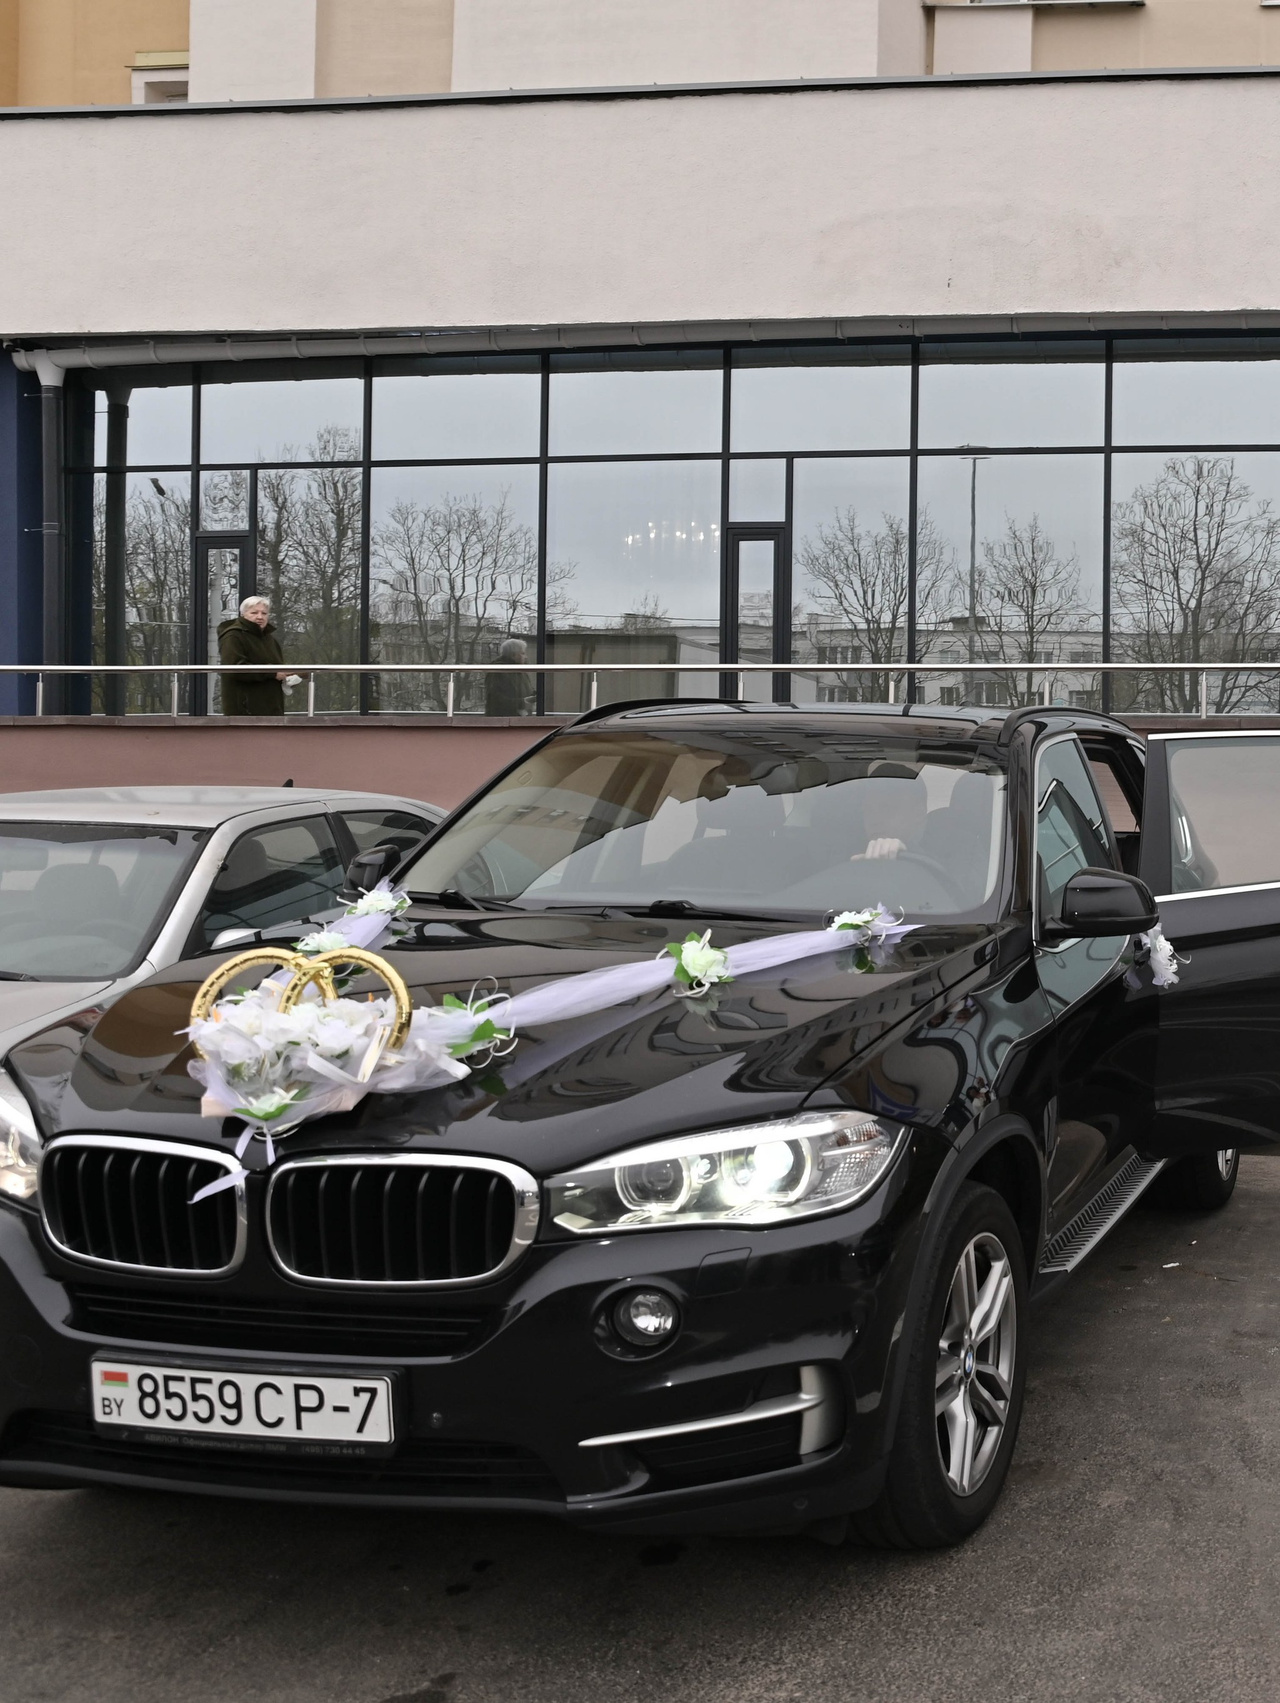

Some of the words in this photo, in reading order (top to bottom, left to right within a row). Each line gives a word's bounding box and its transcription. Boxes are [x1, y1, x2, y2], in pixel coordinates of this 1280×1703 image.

[101, 1397, 124, 1416] BY
[137, 1373, 243, 1426] 8559
[254, 1381, 378, 1434] CP-7
